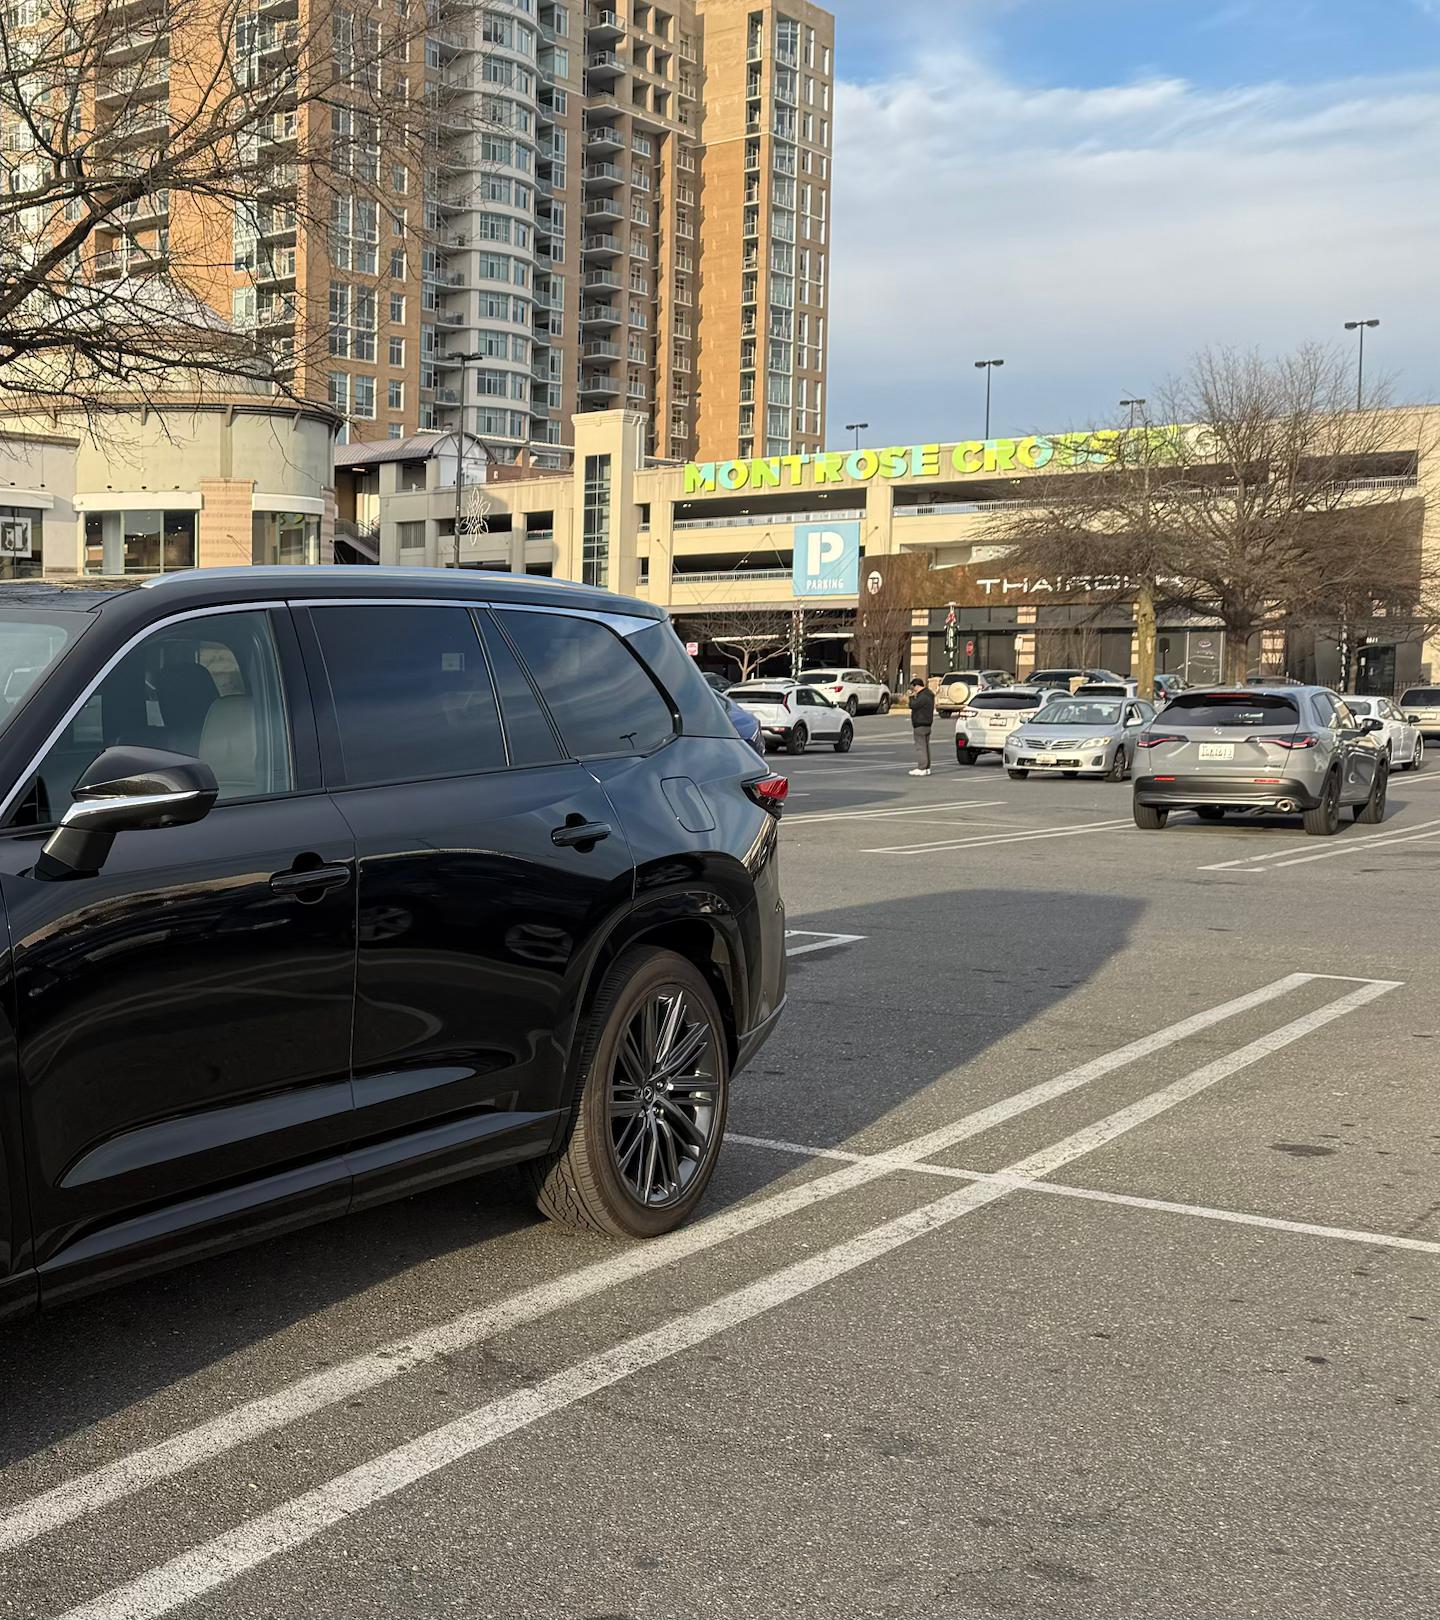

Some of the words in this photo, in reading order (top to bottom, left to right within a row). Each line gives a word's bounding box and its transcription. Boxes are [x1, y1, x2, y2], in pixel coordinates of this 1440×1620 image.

[684, 443, 940, 493] MONTROSE
[807, 531, 845, 576] P
[806, 578, 844, 590] PARKING
